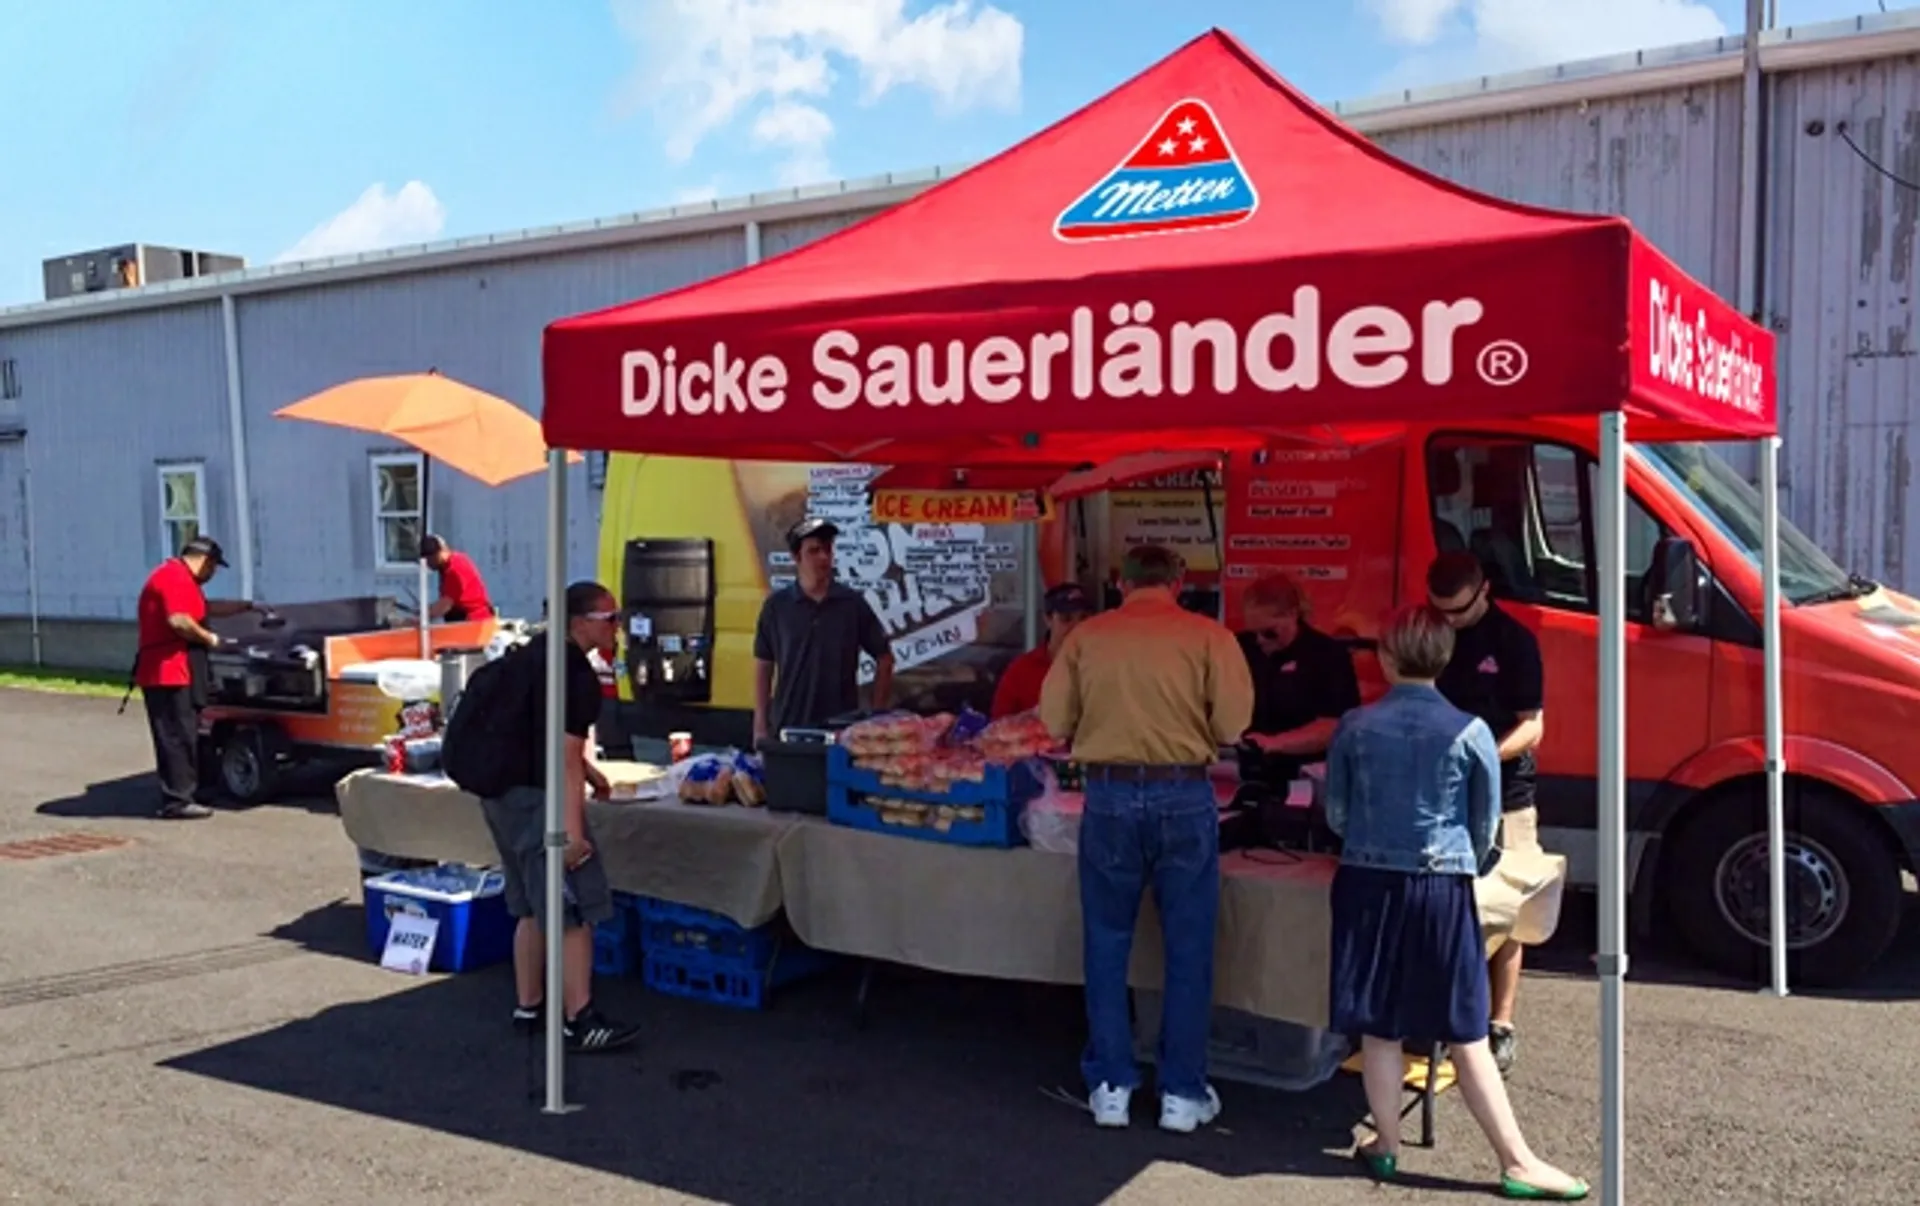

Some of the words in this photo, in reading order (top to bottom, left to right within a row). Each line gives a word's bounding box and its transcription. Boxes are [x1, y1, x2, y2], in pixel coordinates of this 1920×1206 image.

[1092, 175, 1237, 219] Metten
[621, 340, 789, 417] Dicke
[811, 284, 1484, 410] Sauerländer
[1649, 277, 1693, 391] Dicke
[876, 493, 913, 518] ICE
[921, 494, 1008, 519] CREAM
[391, 931, 431, 950] WATER
